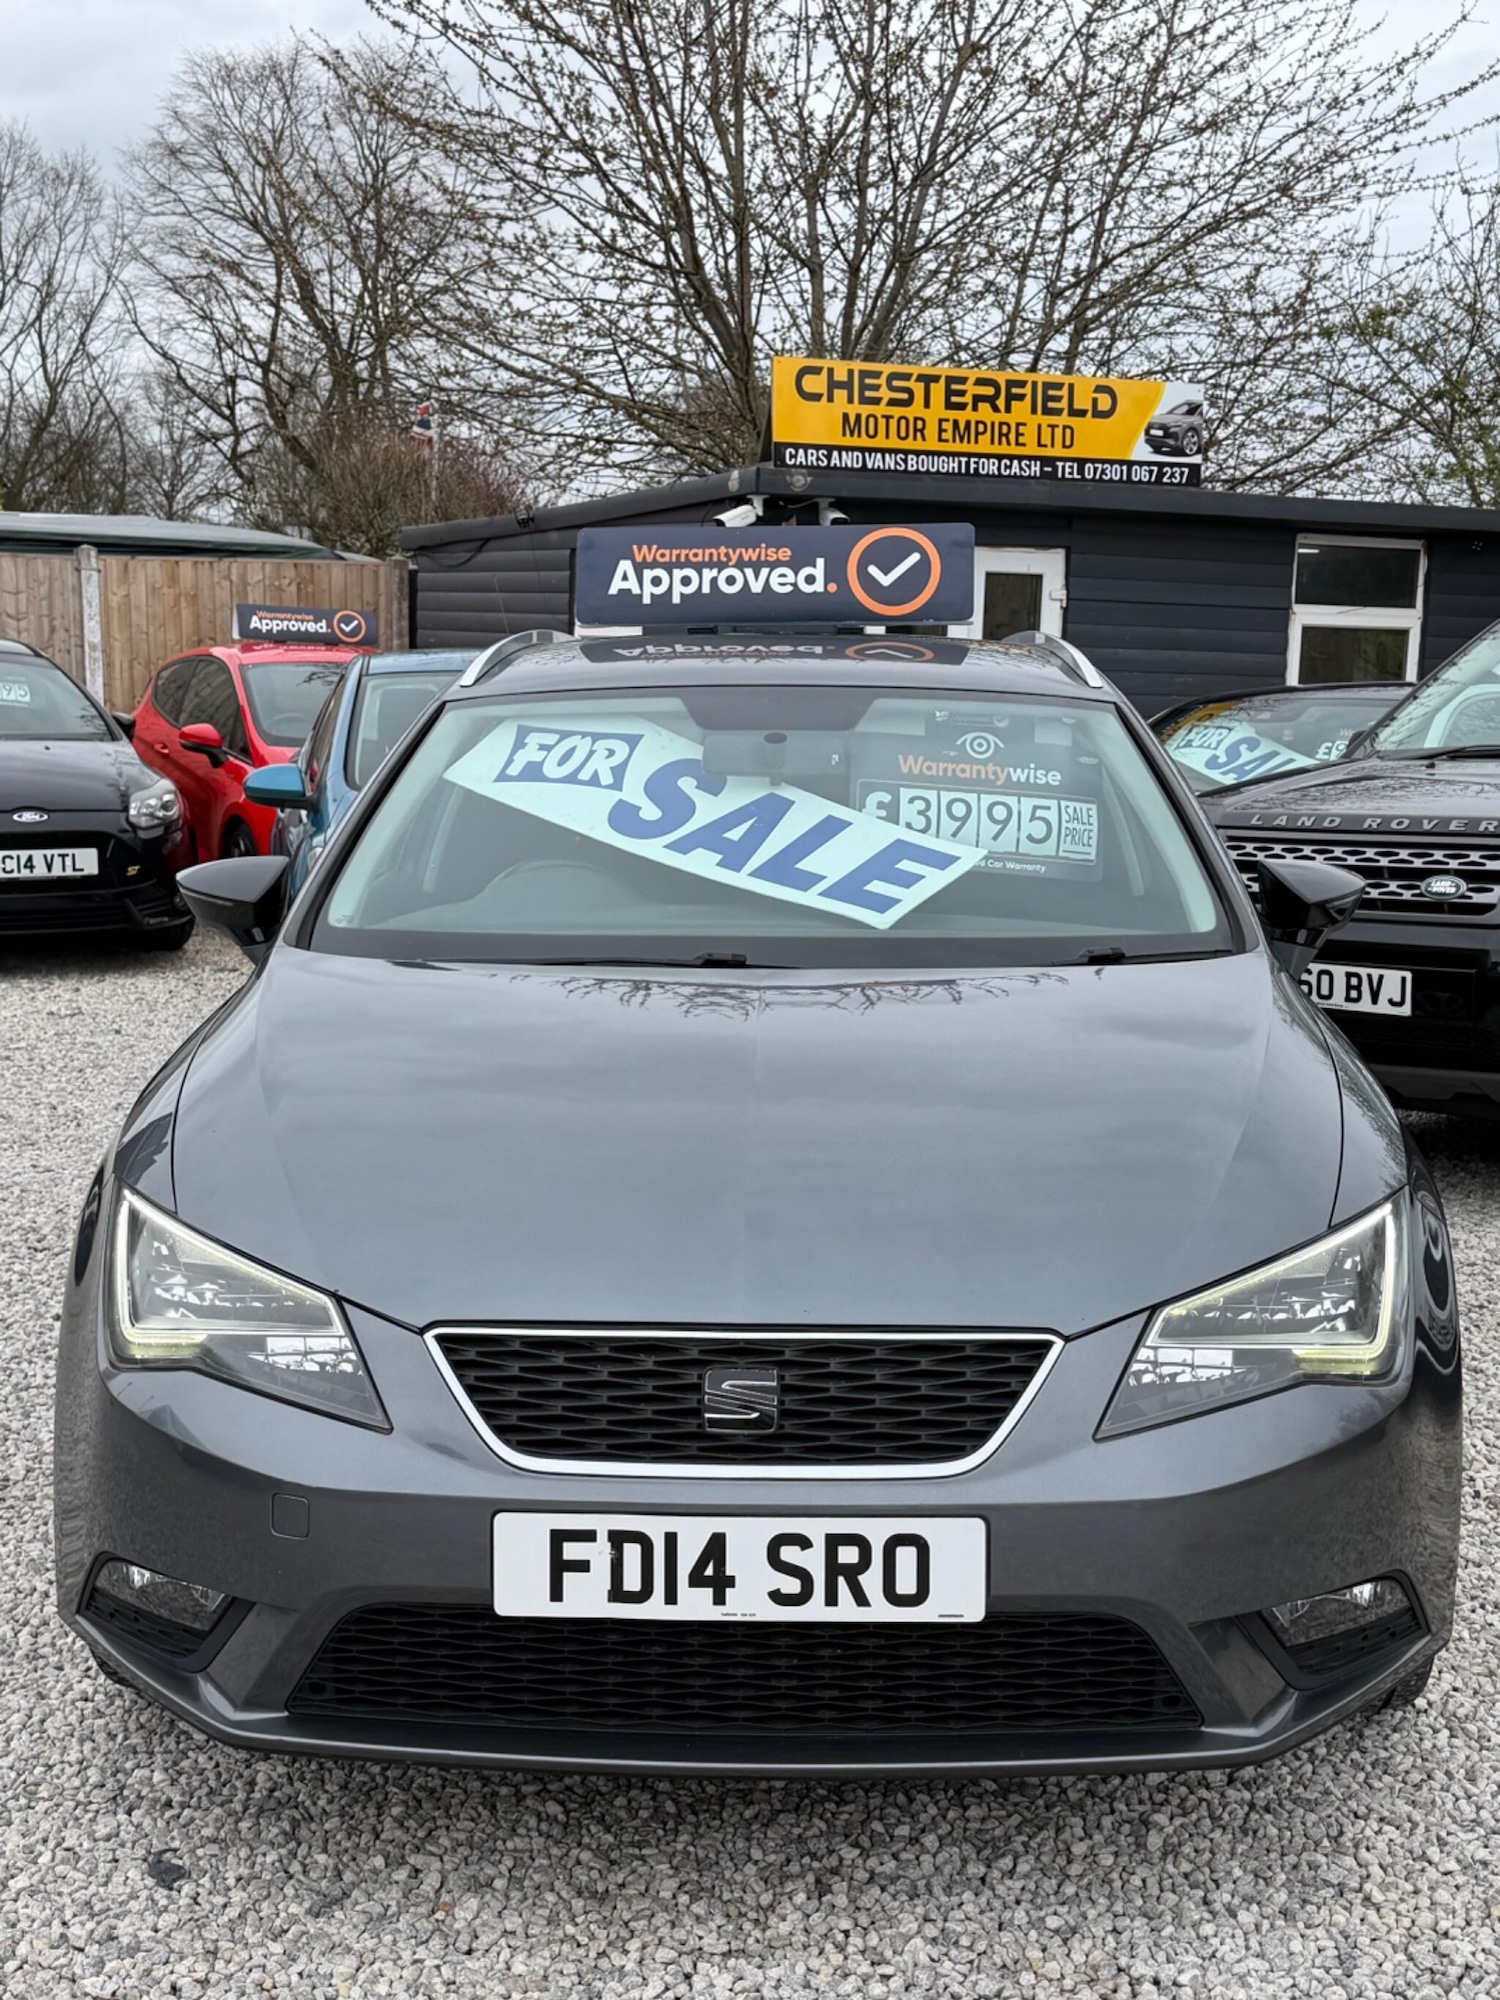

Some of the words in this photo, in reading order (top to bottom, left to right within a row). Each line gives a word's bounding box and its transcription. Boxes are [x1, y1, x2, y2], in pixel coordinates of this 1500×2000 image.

[795, 365, 1118, 419] CHESTERFIELD
[841, 411, 927, 442] MOTOR
[937, 418, 1027, 448] EMPIRE
[1036, 422, 1075, 449] LTD
[785, 447, 828, 467] CARS
[830, 449, 863, 469] AND
[865, 451, 908, 472] VANS
[907, 454, 968, 475] BOUGHT
[970, 457, 999, 476] FOR
[1000, 459, 1040, 477] CASH
[1056, 461, 1081, 479] TEL
[1084, 463, 1127, 481] 07301
[1131, 465, 1158, 482] 067
[1162, 467, 1190, 484] 237
[631, 543, 792, 566] Warrantywise
[607, 557, 838, 605] Approved.
[1179, 726, 1227, 750] FOR
[898, 754, 1062, 786] Warrantywise
[505, 732, 631, 786] FOR
[607, 758, 962, 915] SALE
[1064, 804, 1094, 826] SALE
[1250, 814, 1341, 828] LAND
[1363, 817, 1500, 832] ROVER
[1063, 826, 1094, 848] PRICE
[43, 853, 85, 873] VTL
[1344, 971, 1407, 1008] BVJ
[549, 1528, 736, 1606] FD14
[766, 1532, 931, 1608] SRO
